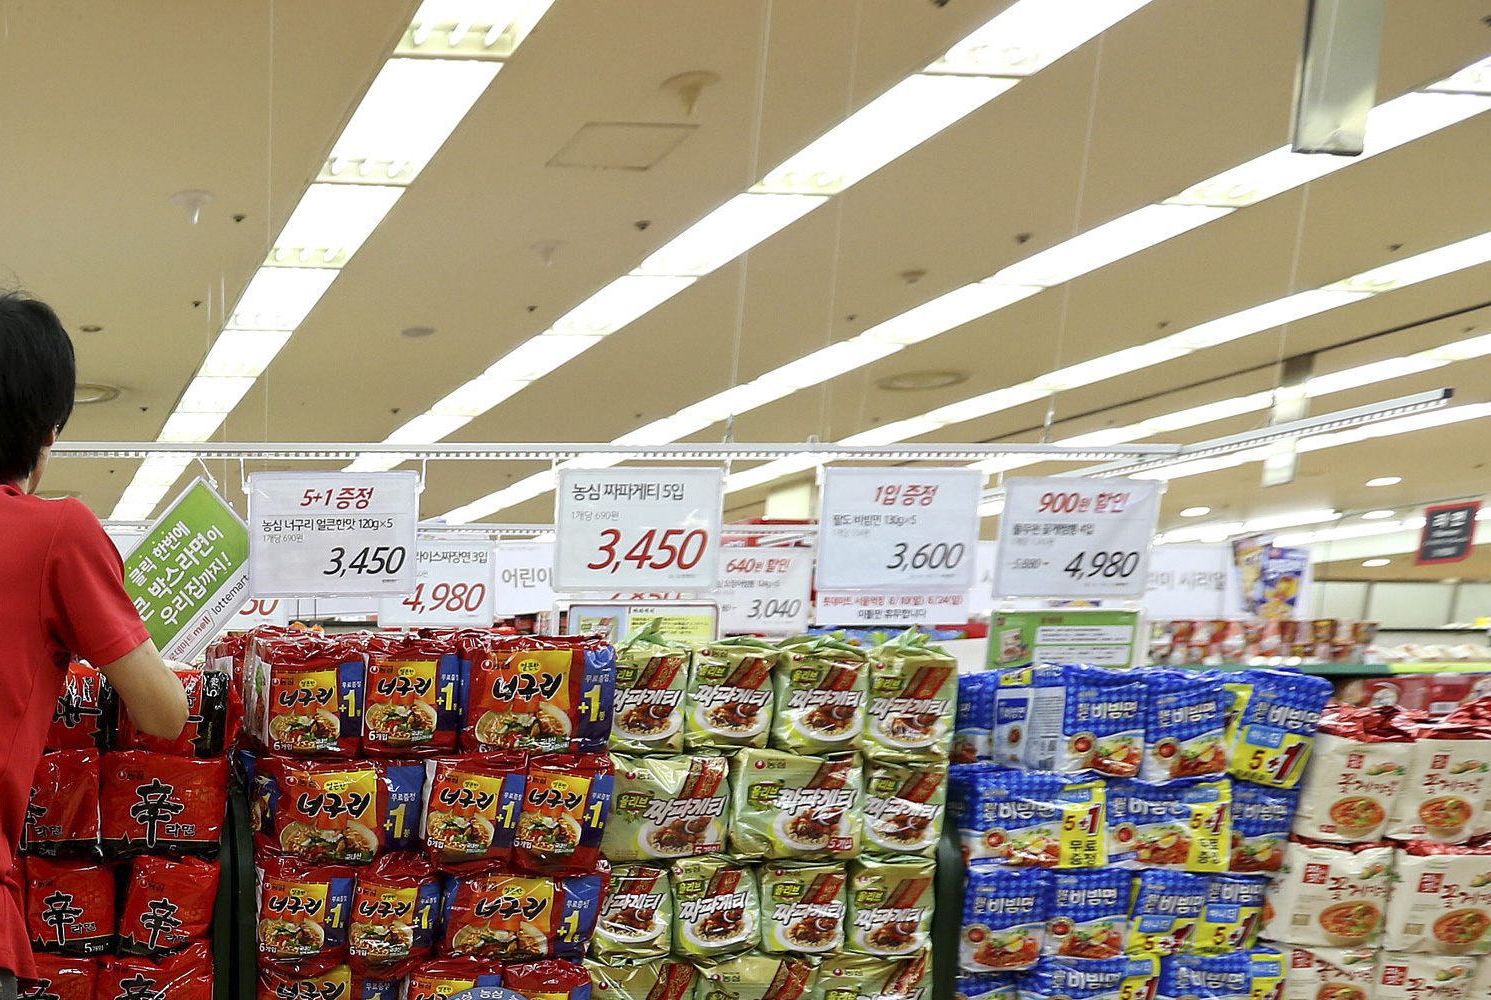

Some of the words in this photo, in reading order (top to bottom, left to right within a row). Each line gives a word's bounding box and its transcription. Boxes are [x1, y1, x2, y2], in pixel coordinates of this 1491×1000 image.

[300, 488, 334, 507] 5+1
[336, 487, 375, 510] 증정
[572, 483, 601, 501] 농심
[603, 483, 659, 501] 짜파게티
[663, 483, 685, 500] 5입
[874, 485, 901, 506] 1입
[902, 484, 939, 506] 증정
[1038, 492, 1092, 513] 900원
[1095, 492, 1131, 513] 할인
[262, 519, 283, 532] 농심
[285, 518, 314, 531] 너구리
[317, 518, 356, 531] 얼큰한맛
[595, 511, 620, 522] 690원
[128, 556, 158, 588] 클릭
[152, 520, 192, 562] 한번에
[147, 524, 226, 599] 박스라면이
[323, 546, 406, 577] 3,450
[473, 551, 488, 563] 3입
[587, 528, 708, 574] 3,450
[887, 542, 965, 573] 3,600
[726, 557, 763, 573] 640원
[765, 557, 791, 573] 할인
[1064, 551, 1141, 580] 4,980
[160, 551, 234, 626] 우리집까지!
[211, 573, 249, 616] lottemart
[403, 582, 486, 614] 4,980
[746, 598, 801, 619] 3,040
[279, 686, 334, 708] 너구리
[694, 683, 773, 707] 짜파게티
[870, 698, 953, 719] 짜파게티
[1093, 699, 1138, 719] 비빔면
[751, 785, 780, 799] 올리브
[129, 778, 184, 849] 辛
[297, 791, 371, 819] 너구리
[645, 796, 729, 824] 짜파게티
[165, 823, 195, 837] 라면
[479, 989, 504, 999] 농심
